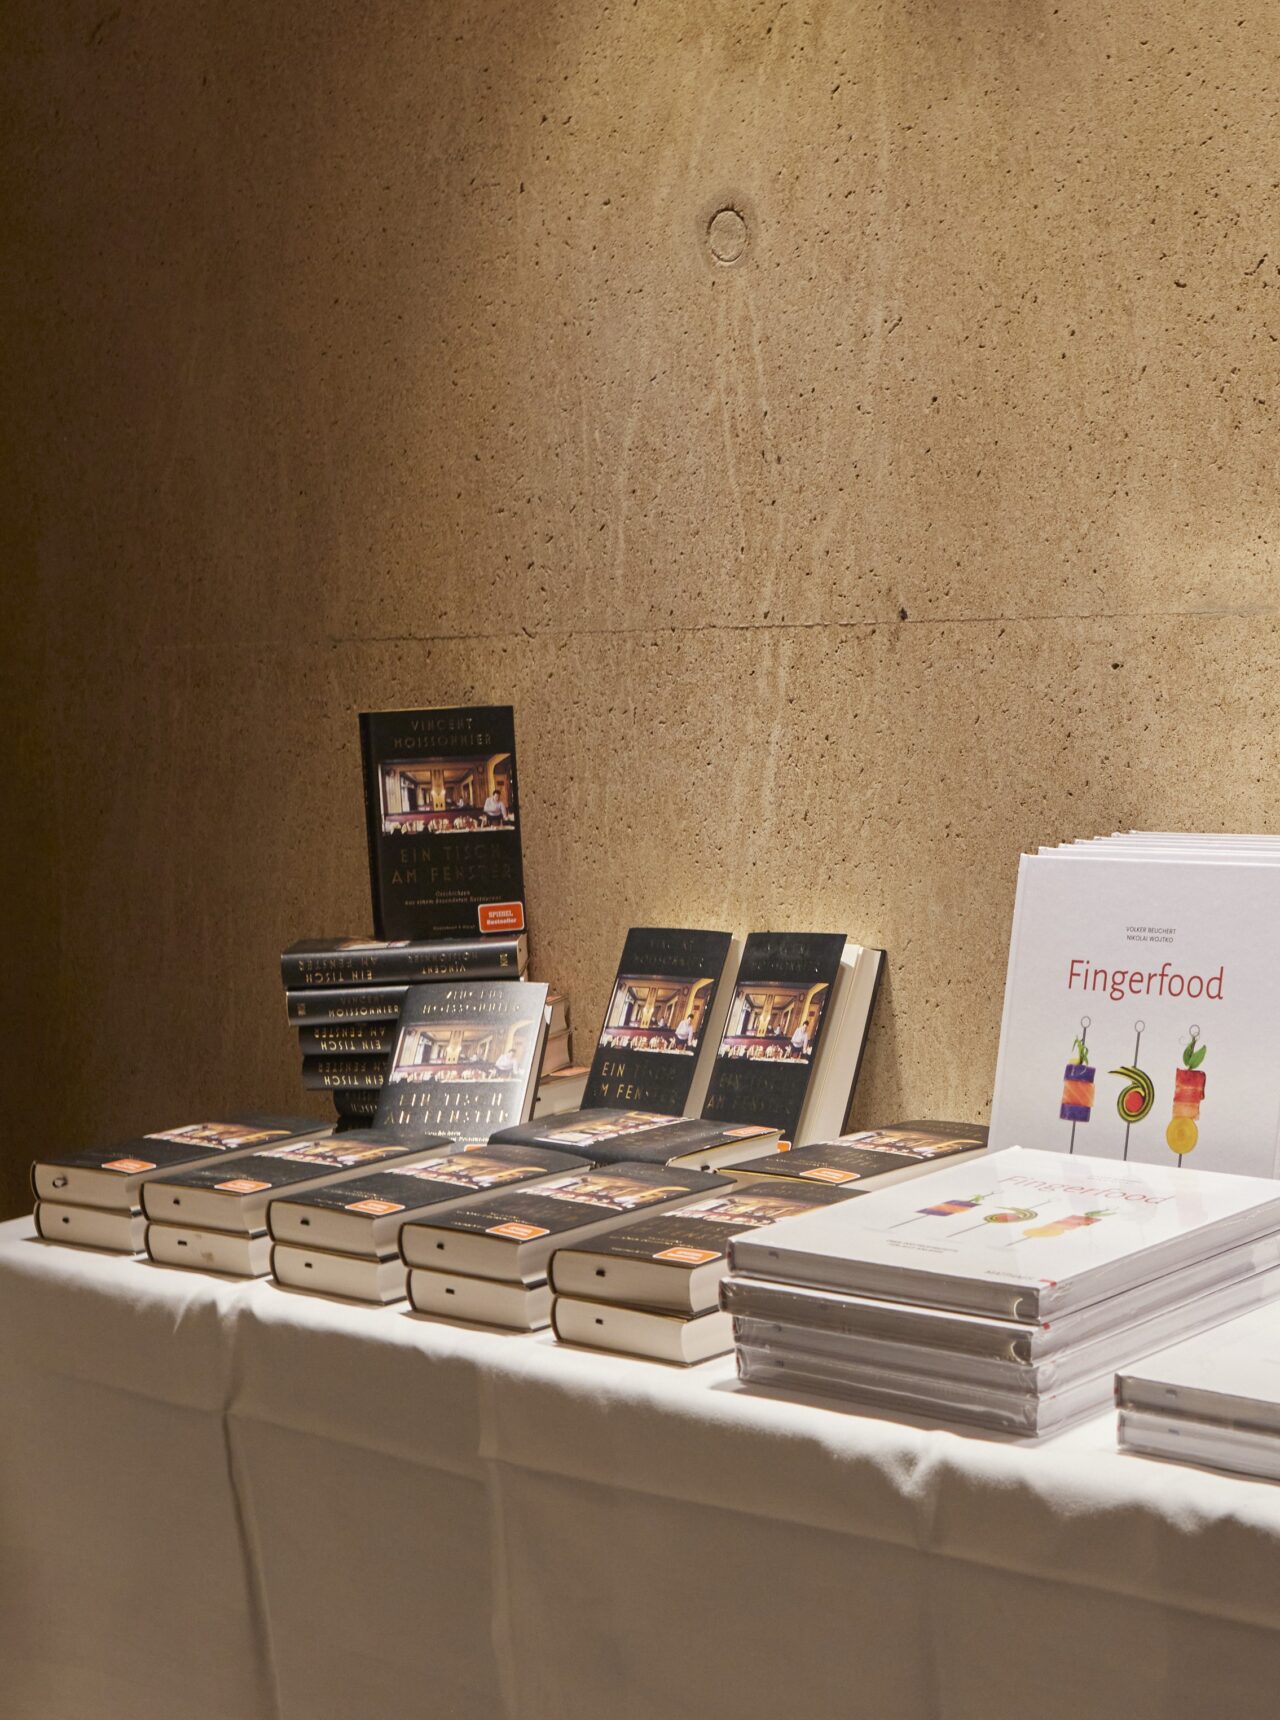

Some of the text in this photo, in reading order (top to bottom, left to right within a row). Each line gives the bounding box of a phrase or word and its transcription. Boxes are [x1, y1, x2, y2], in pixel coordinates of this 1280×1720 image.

[1126, 926, 1147, 934] VOLKER
[1068, 959, 1224, 1001] Fingerfood
[320, 1040, 382, 1051] EIN TISCH
[601, 1062, 626, 1077] EIN
[323, 1074, 385, 1086] EIN TISCH
[998, 1175, 1176, 1205] Fingerfood
